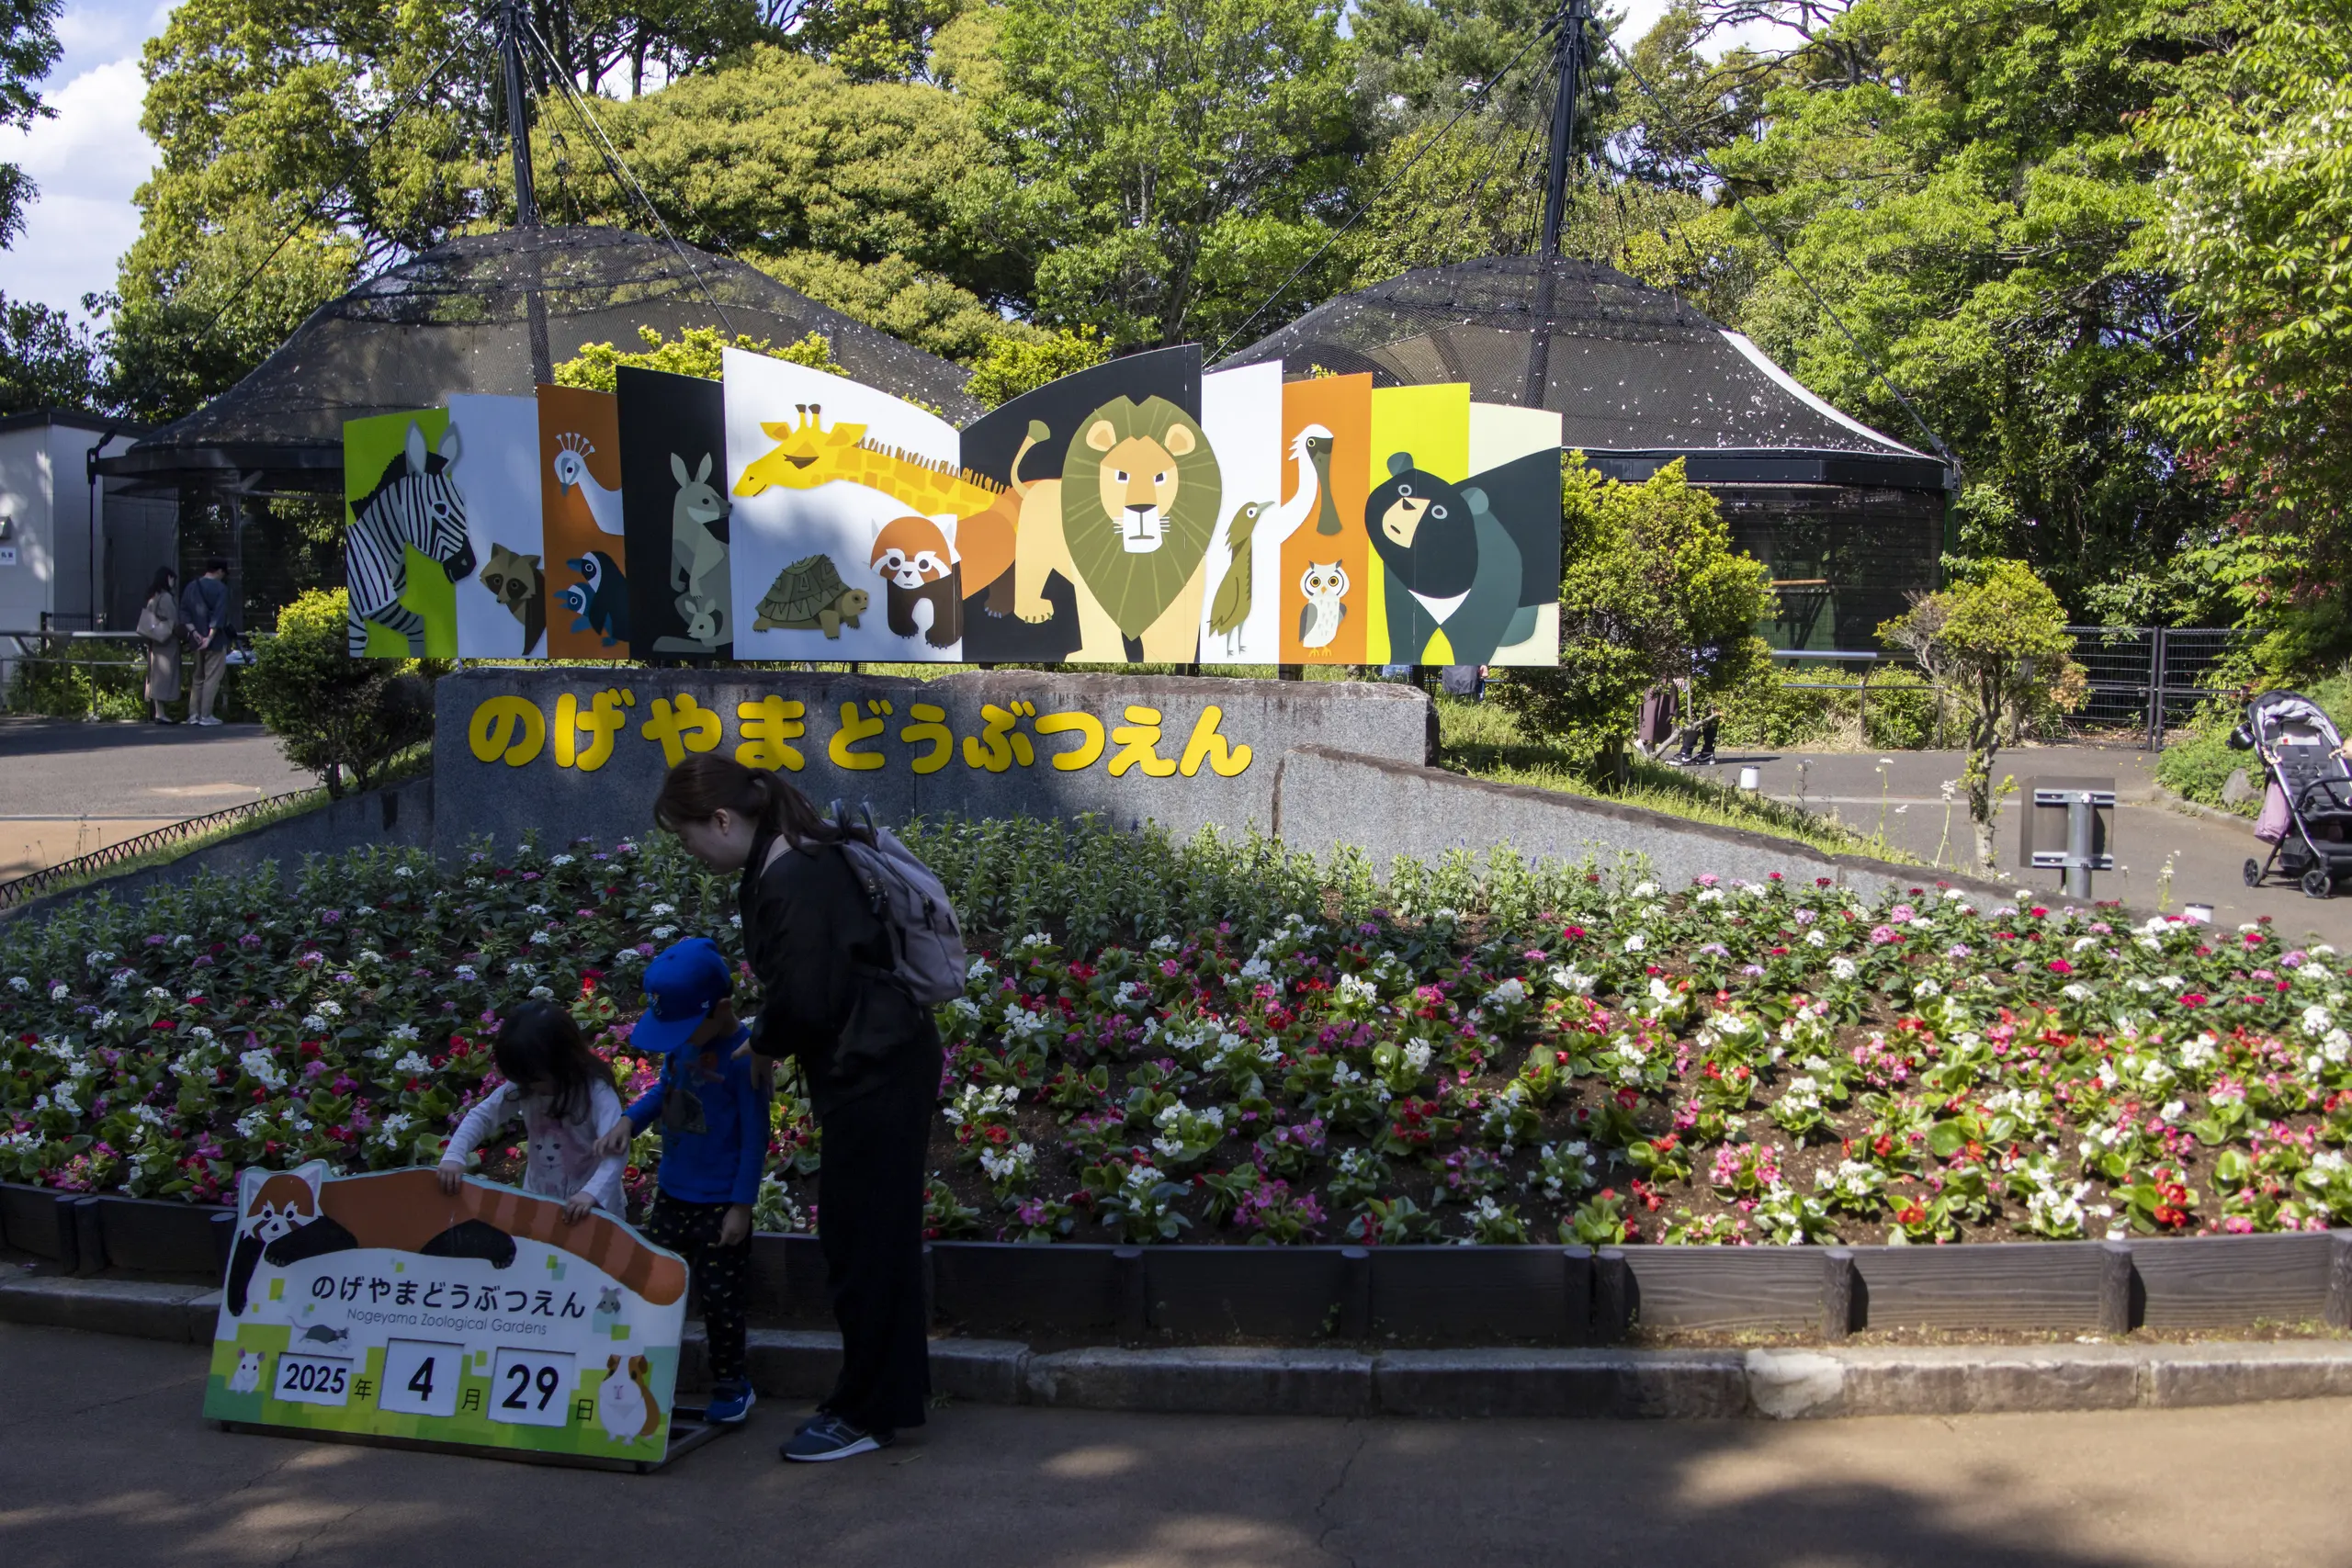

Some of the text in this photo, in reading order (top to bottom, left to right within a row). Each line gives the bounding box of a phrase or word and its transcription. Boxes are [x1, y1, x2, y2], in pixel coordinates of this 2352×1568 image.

[469, 688, 1253, 777] のげやまどうぶつえん
[311, 1275, 585, 1319] のげやまどうぶつえん
[346, 1308, 548, 1336] Nogeyama Zoological Gardens
[283, 1357, 594, 1422] 2025 年 4 月 29 日
